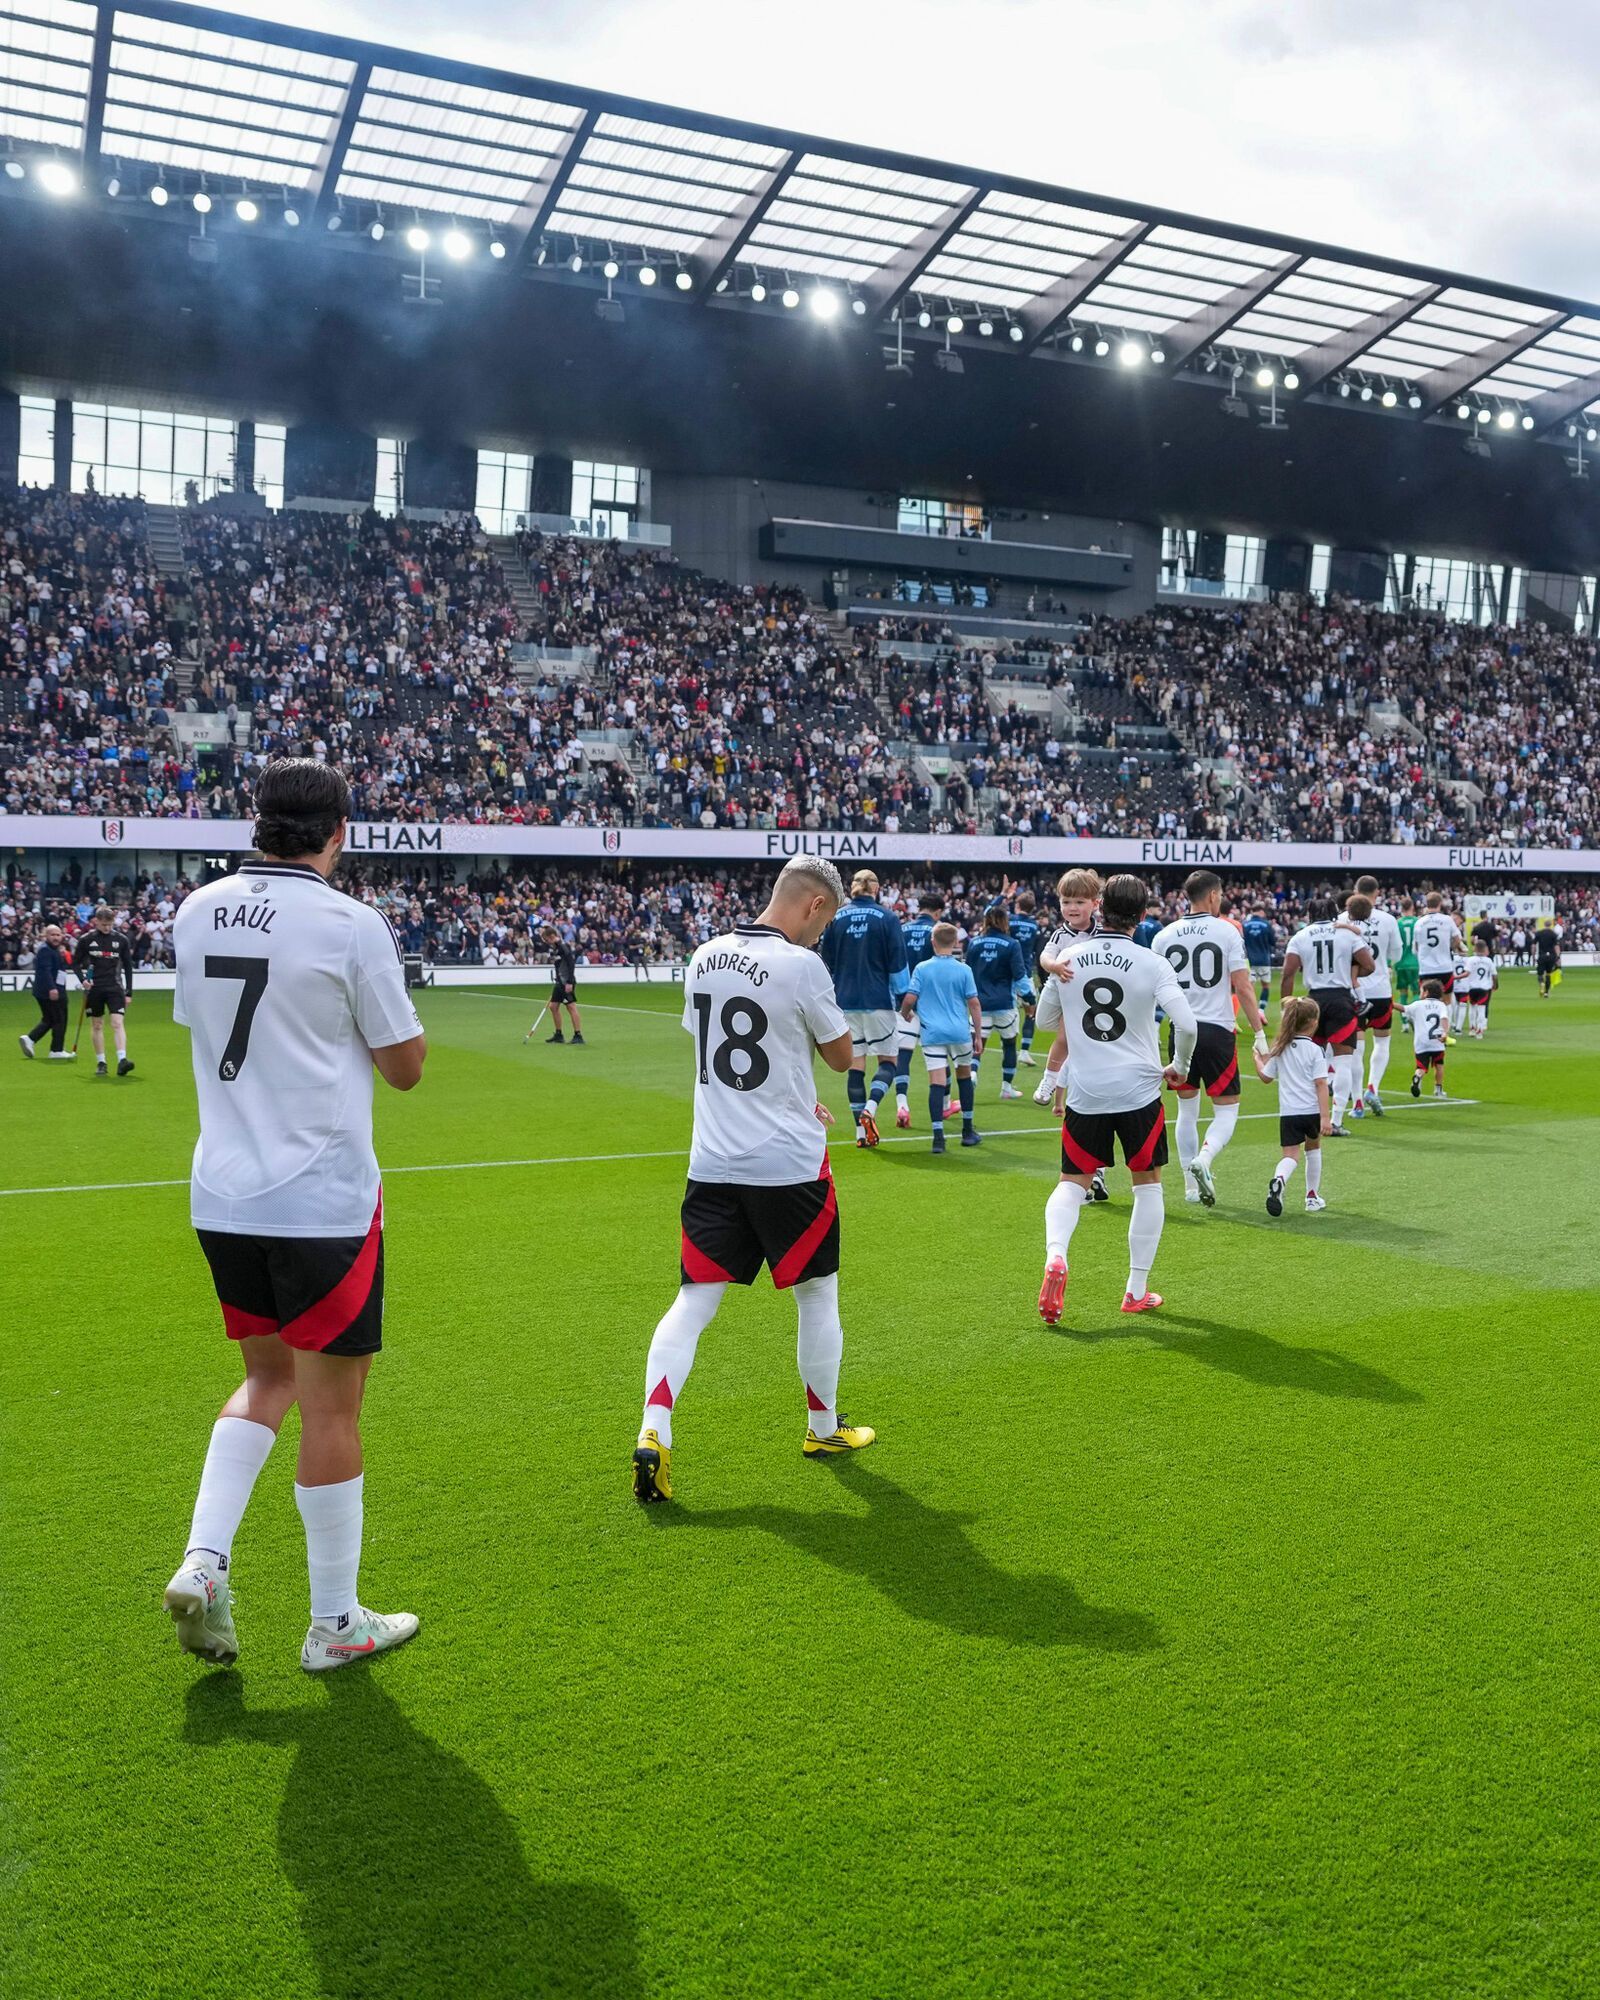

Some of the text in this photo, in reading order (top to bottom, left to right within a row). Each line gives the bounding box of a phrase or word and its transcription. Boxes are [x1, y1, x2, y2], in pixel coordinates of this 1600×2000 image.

[350, 826, 442, 850] LHAM
[767, 834, 878, 857] FULHAM
[1142, 842, 1233, 863] FULHAM
[1449, 849, 1524, 868] FULHAM
[214, 899, 277, 935] RAÚL
[1176, 924, 1208, 937] LUKIĆ
[1426, 927, 1440, 948] 5
[696, 953, 769, 987] ANDREAS
[1077, 953, 1134, 972] WILSON
[1166, 941, 1223, 989] 20
[1313, 940, 1334, 974] 11
[204, 955, 269, 1082] 7
[1082, 977, 1127, 1042] 8
[1426, 1013, 1442, 1040] 2
[693, 993, 769, 1092] 18
